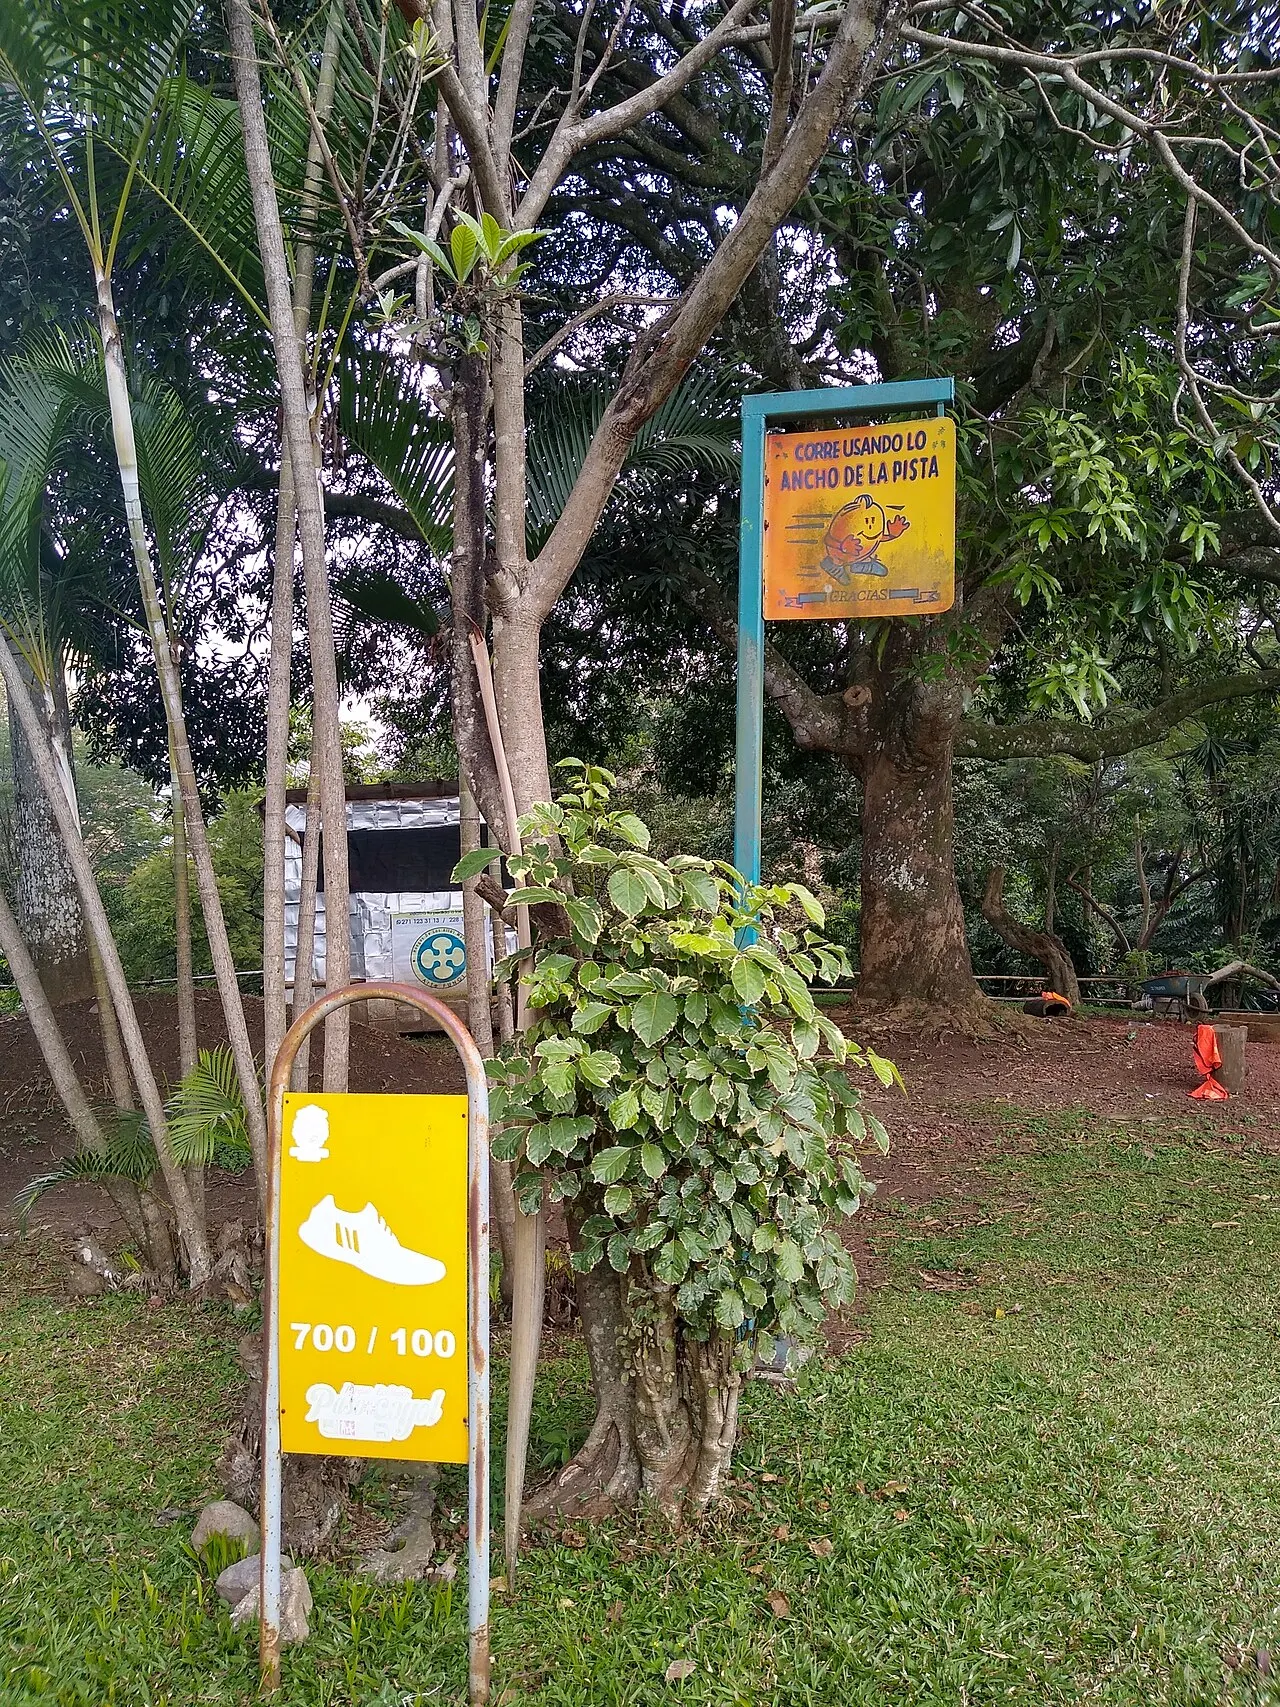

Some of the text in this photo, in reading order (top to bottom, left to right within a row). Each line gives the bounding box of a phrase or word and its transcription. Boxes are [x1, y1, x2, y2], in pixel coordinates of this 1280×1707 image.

[795, 430, 927, 462] CORRE USANDO LO
[780, 455, 939, 491] ANCHO DE LA PISTA
[831, 588, 888, 602] GRACIAS
[290, 1322, 456, 1358] 700 / 100
